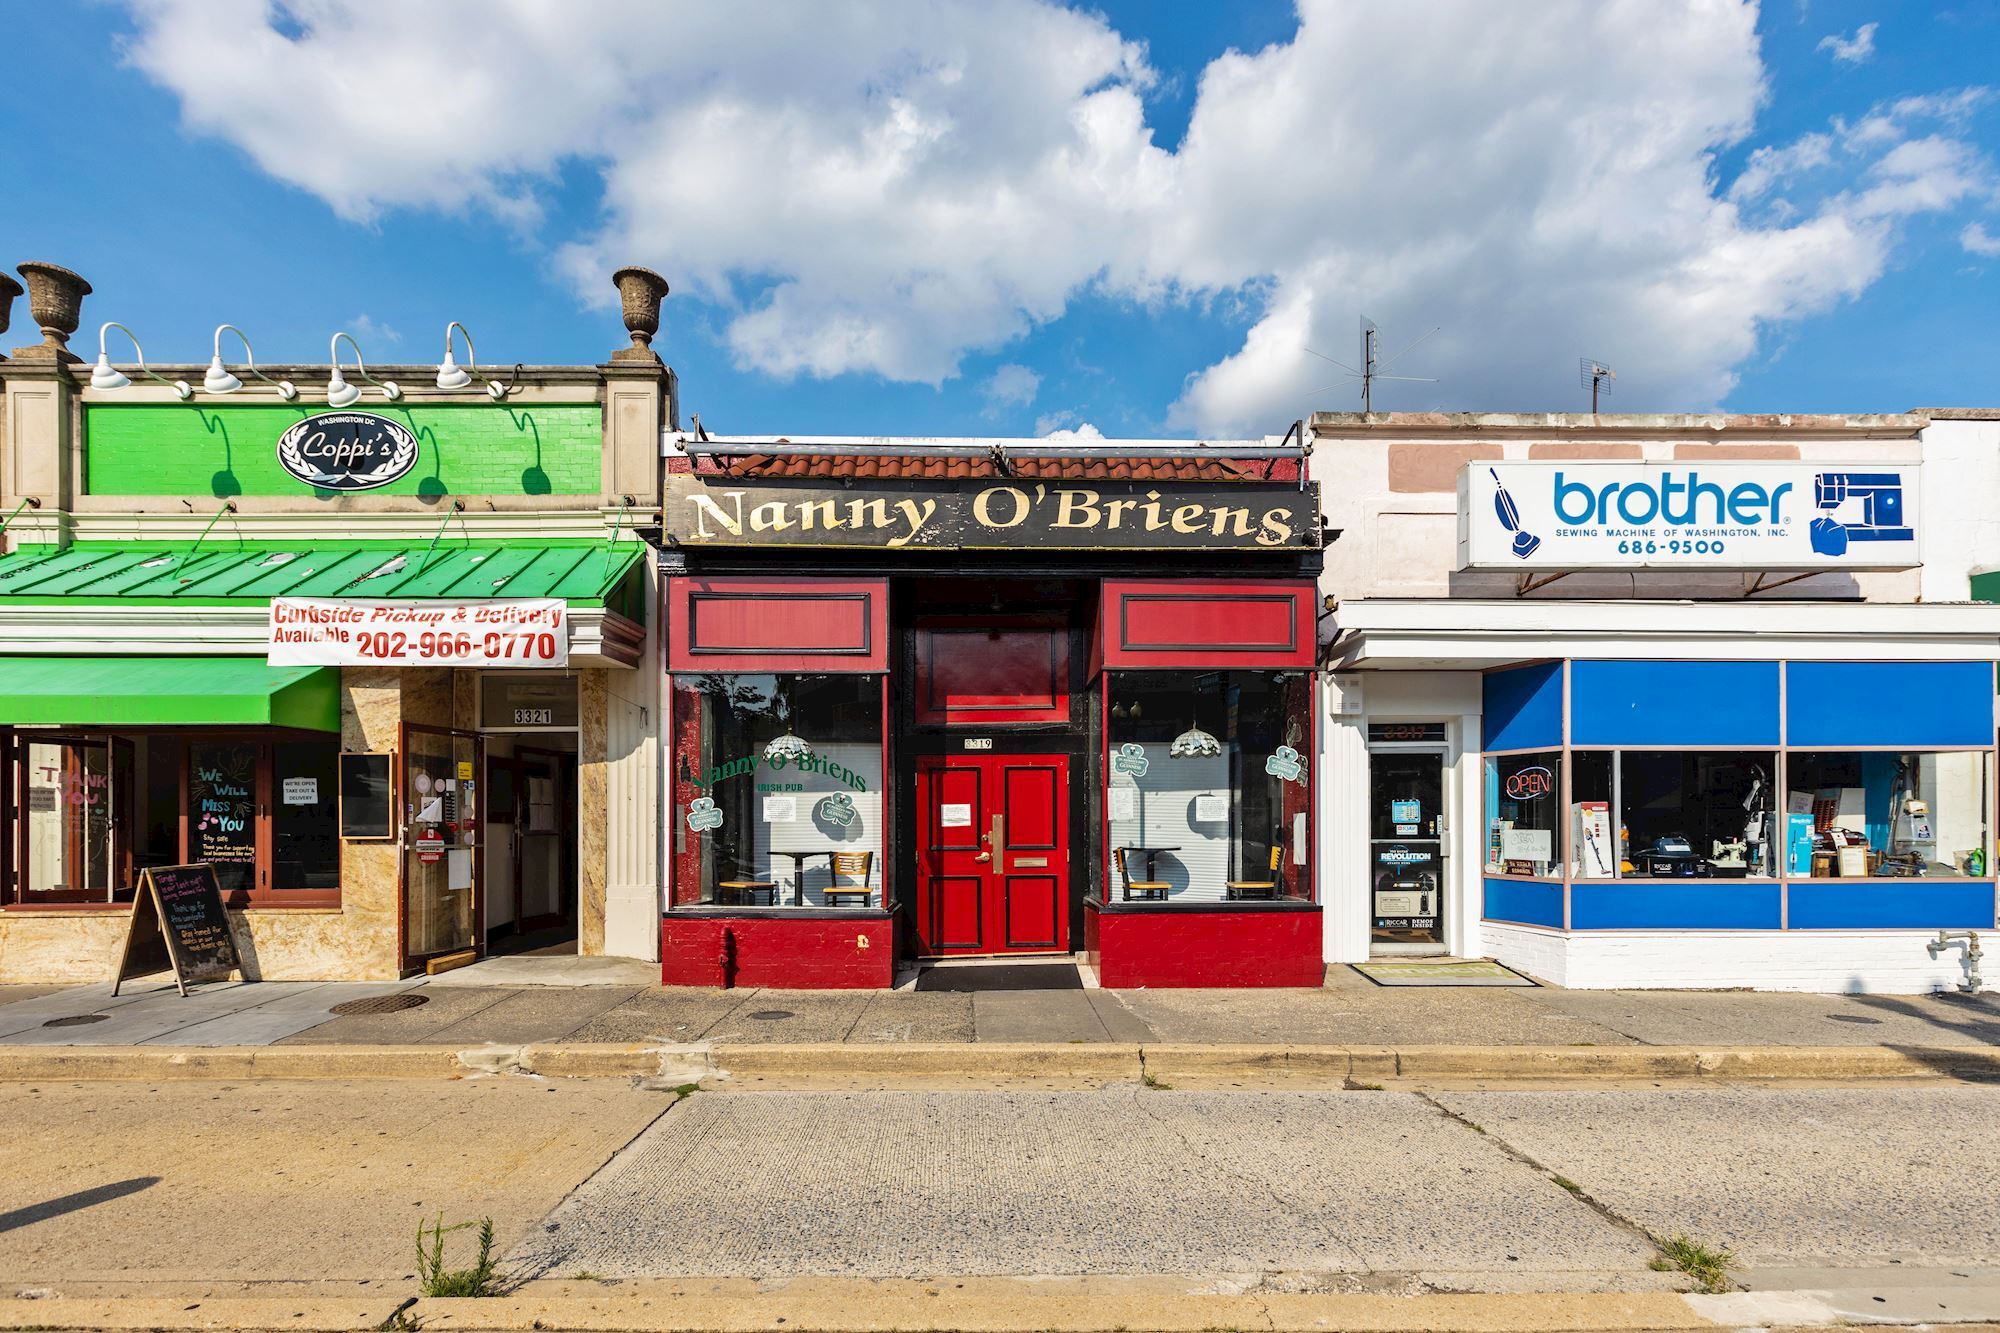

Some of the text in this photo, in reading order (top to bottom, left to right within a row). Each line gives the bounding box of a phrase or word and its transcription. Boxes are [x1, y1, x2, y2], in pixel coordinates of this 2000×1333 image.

[318, 416, 376, 426] WASHINGTON DC
[303, 432, 392, 467] Coppi's
[1553, 472, 1793, 525] brother
[690, 484, 1294, 547] Nanny O'Briens
[1555, 529, 1598, 537] SEWING
[1606, 529, 1656, 537] MACHINE
[1664, 529, 1678, 537] OF
[1768, 529, 1788, 537] INC.
[1618, 540, 1725, 555] 686-9500
[274, 604, 563, 628] Curbside Pickup & Delivery
[273, 627, 350, 643] Available
[356, 631, 556, 659] 202-966-0770
[515, 709, 551, 723] 3321
[1384, 726, 1425, 739] 3317
[965, 739, 991, 748] 3319
[39, 767, 107, 788] THANK
[198, 767, 222, 782] WE
[213, 783, 248, 796] WILL
[1506, 774, 1551, 793] OPEN
[56, 787, 99, 804] YOU
[202, 799, 231, 812] MISS
[218, 815, 244, 832] YOU
[203, 834, 215, 843] Stay
